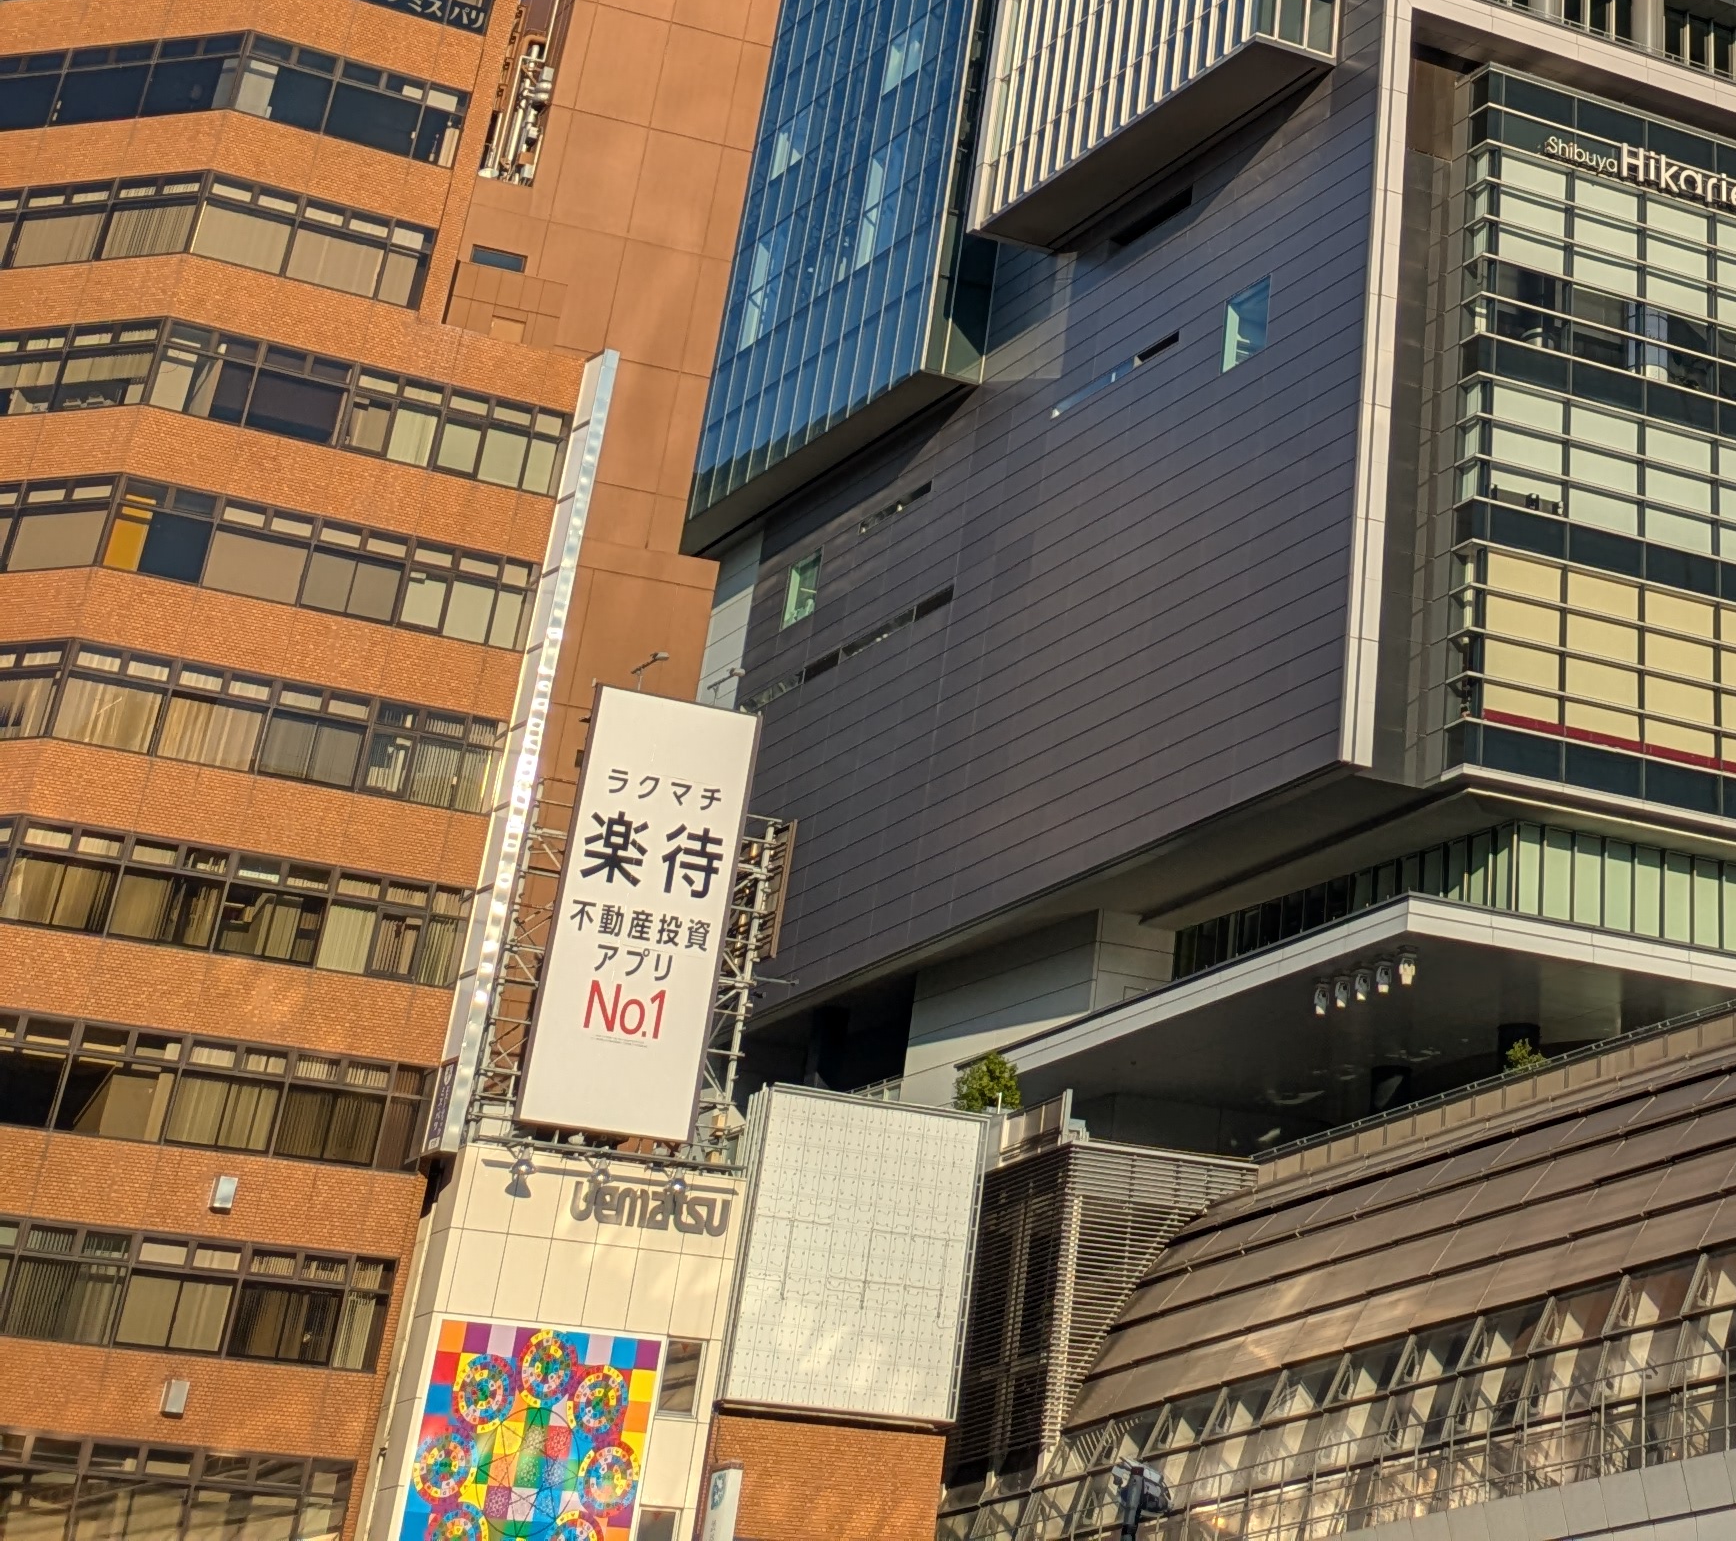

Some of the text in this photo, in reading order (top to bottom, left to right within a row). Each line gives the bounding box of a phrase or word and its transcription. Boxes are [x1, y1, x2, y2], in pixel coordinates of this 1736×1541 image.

[1547, 135, 1618, 173] Shibuya
[607, 768, 722, 811] ラクマチ
[579, 810, 724, 899] 楽待
[569, 898, 711, 952] 不動産投資
[593, 943, 674, 982] アプリ
[582, 979, 667, 1040] No.1
